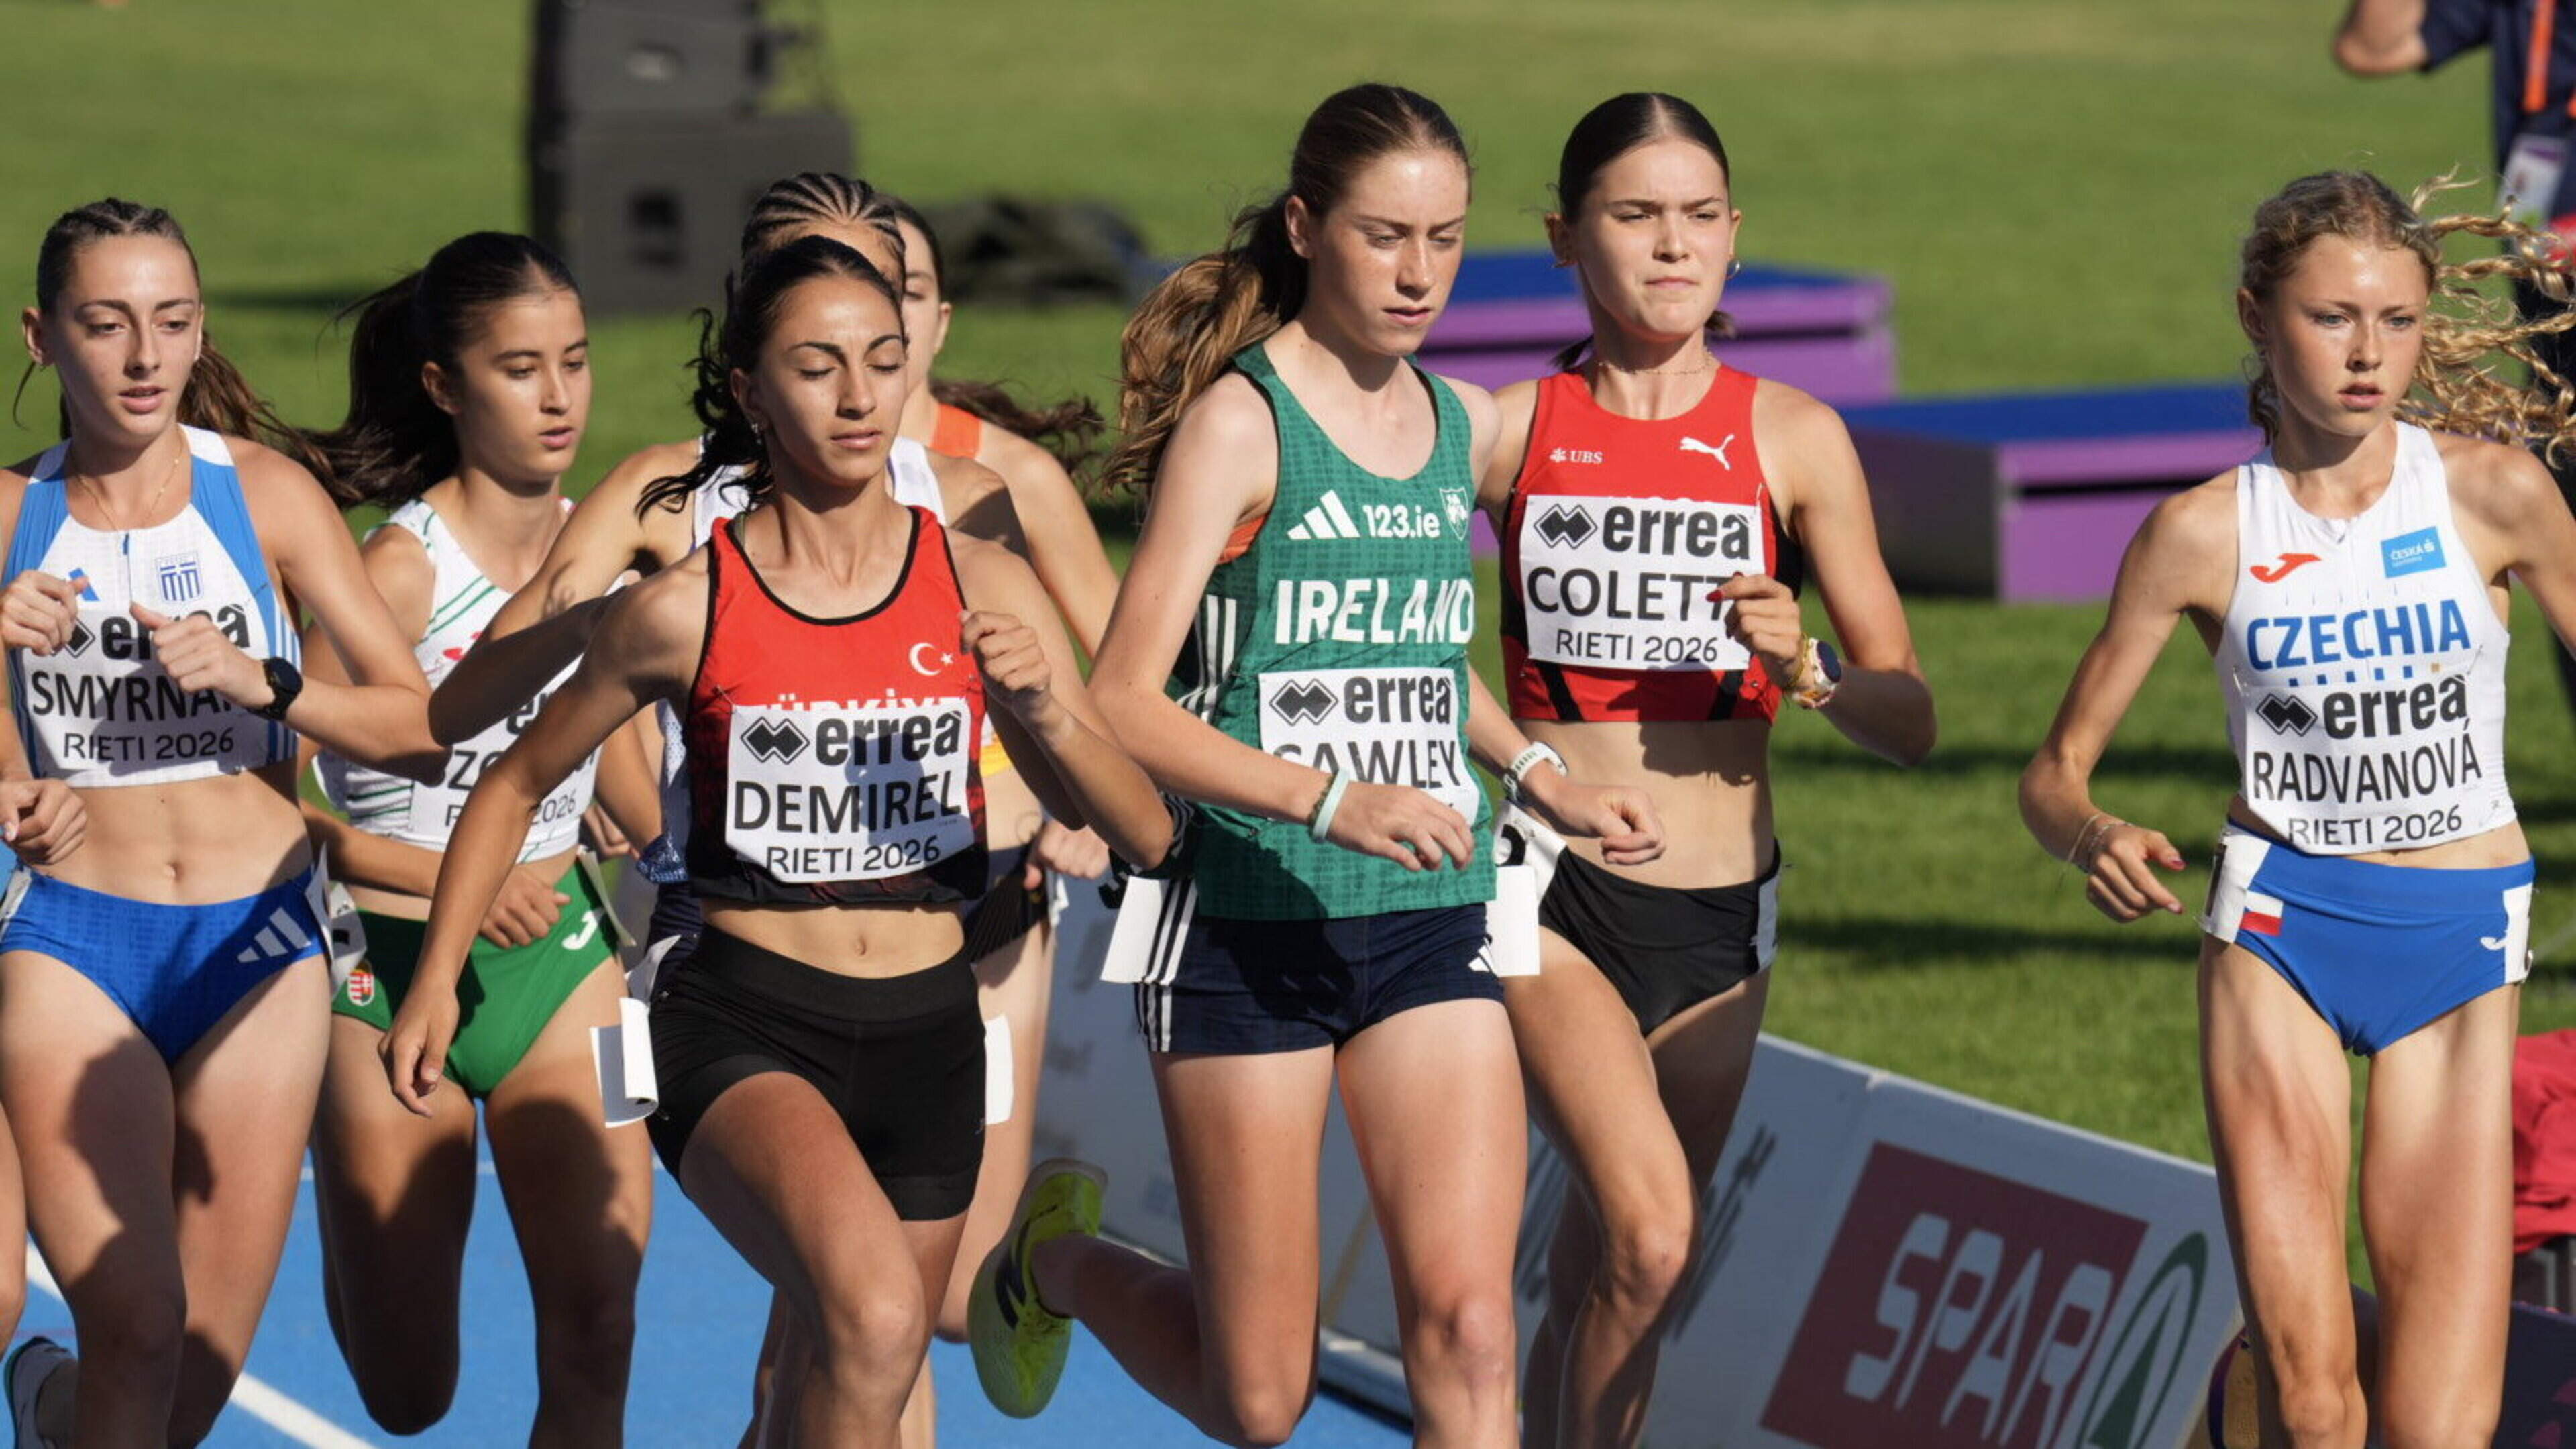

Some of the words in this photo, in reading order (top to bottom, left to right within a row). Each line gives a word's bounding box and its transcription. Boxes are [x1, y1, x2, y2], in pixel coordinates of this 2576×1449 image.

[1570, 451, 1603, 464] UBS
[1362, 504, 1441, 538] 123.ie
[1275, 578, 1474, 645] IRELAND
[1556, 629, 1633, 661] RIETI
[1644, 635, 1718, 663] 2026
[2247, 599, 2471, 672] CZECHIA
[31, 670, 232, 722] SMYRNA
[63, 731, 145, 762] RIETI
[154, 727, 235, 761] 2026
[2253, 718, 2482, 804] RADVANOVÁ
[531, 790, 577, 826] 026
[733, 771, 961, 834] DEMIREL
[2288, 818, 2373, 846] RIETI
[2383, 804, 2463, 843] 2026
[765, 845, 852, 874] RIETI
[863, 835, 940, 872] 2026
[1843, 1212, 2114, 1449] SPAR
